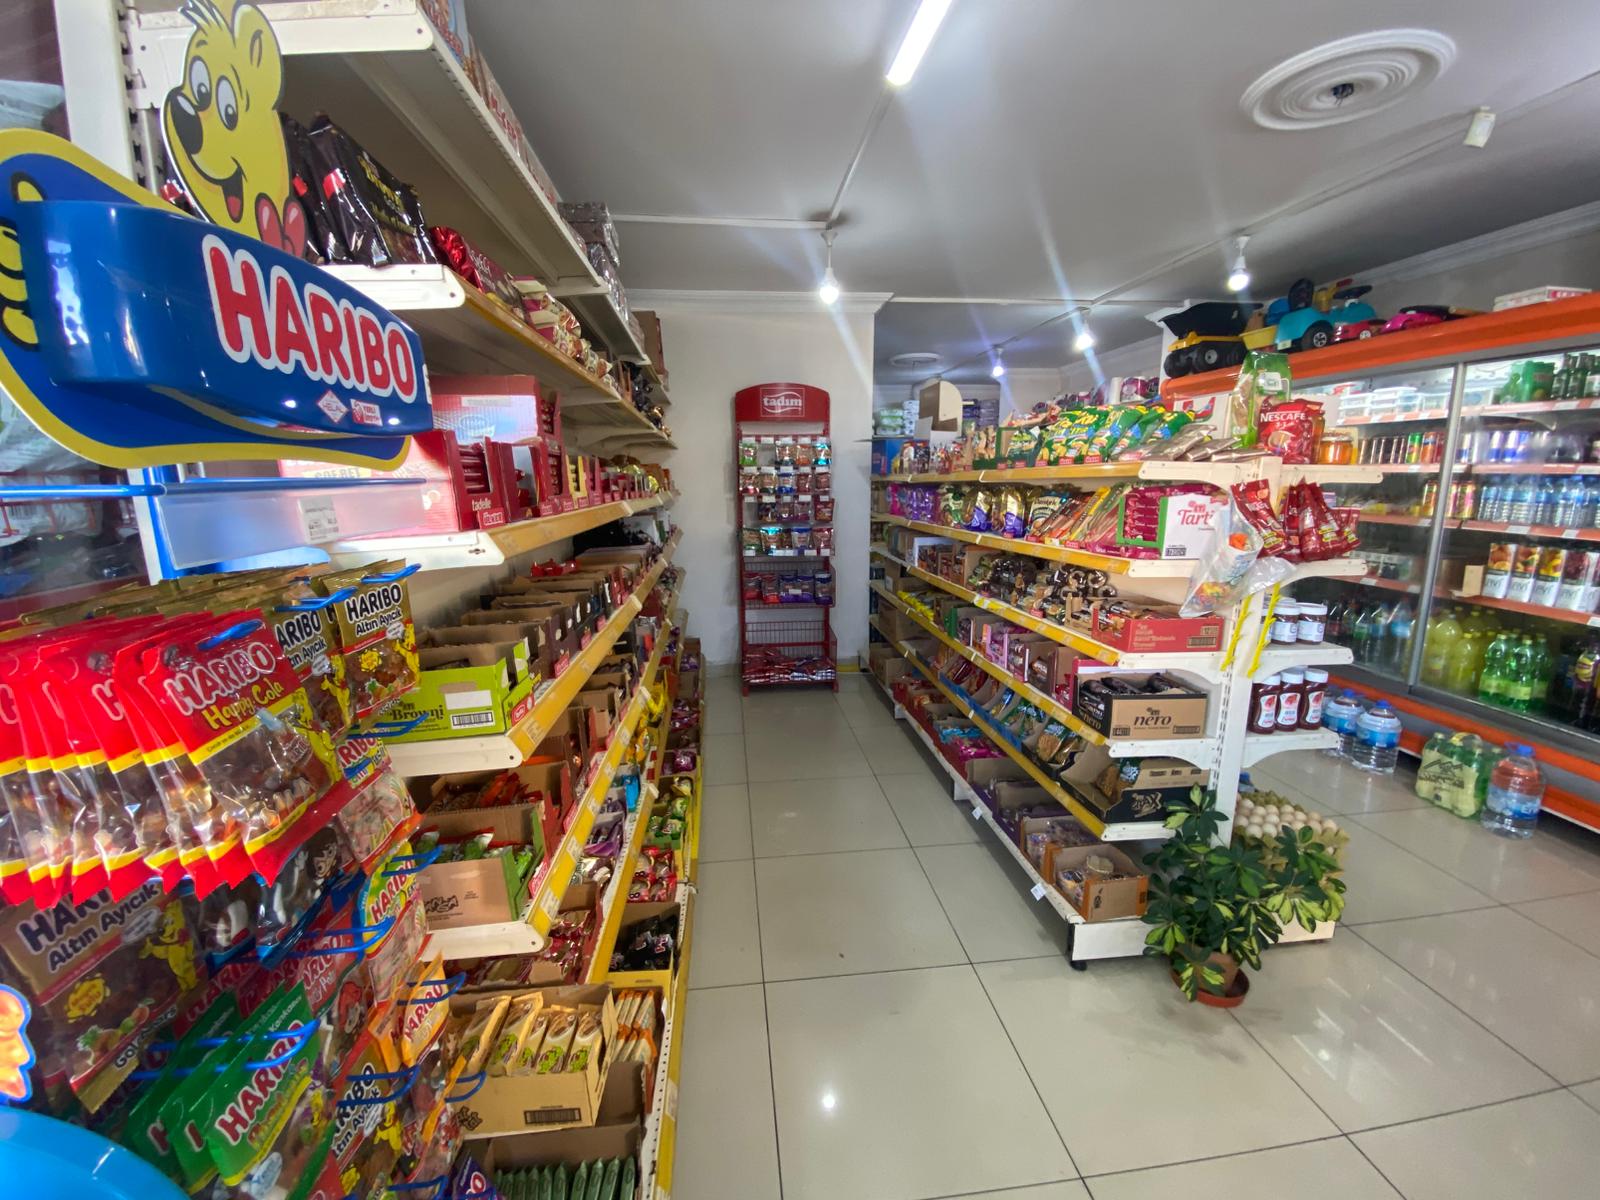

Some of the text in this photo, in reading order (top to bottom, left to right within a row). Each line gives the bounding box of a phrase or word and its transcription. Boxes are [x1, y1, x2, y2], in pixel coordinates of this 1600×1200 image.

[203, 236, 417, 403] HARIBO
[345, 584, 403, 622] HARIBO
[275, 608, 322, 650] ARIBO
[356, 620, 379, 637] Altın
[164, 643, 275, 715] HARIBO
[1133, 715, 1172, 726] nero
[51, 883, 159, 972] Altın Ayıcık
